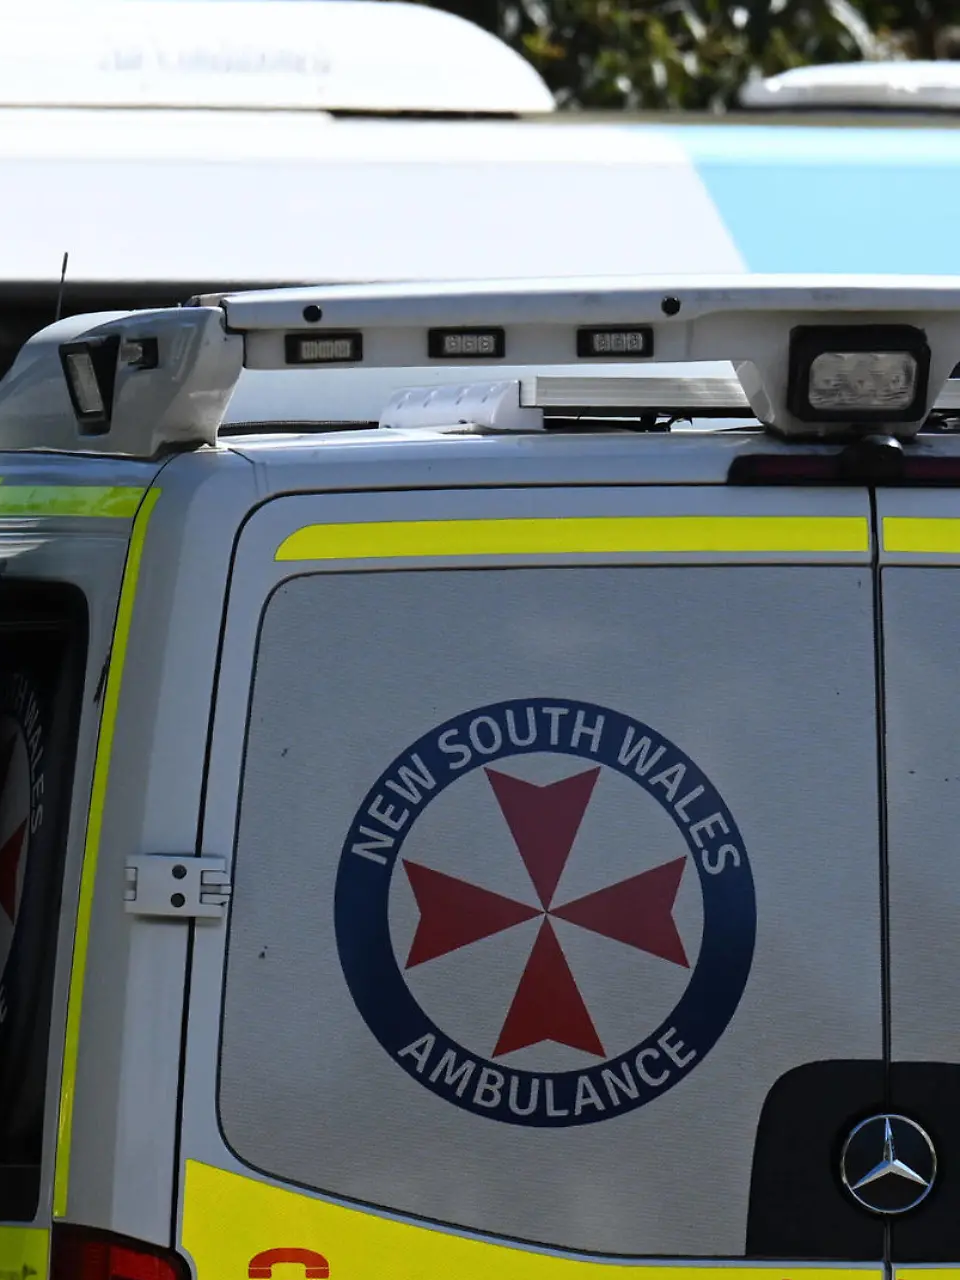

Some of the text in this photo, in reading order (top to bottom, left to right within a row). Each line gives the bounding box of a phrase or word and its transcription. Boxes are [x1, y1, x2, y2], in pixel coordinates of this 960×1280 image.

[352, 706, 741, 876] NEW SOUTH WALES
[397, 1026, 698, 1117] AMBULANCE
